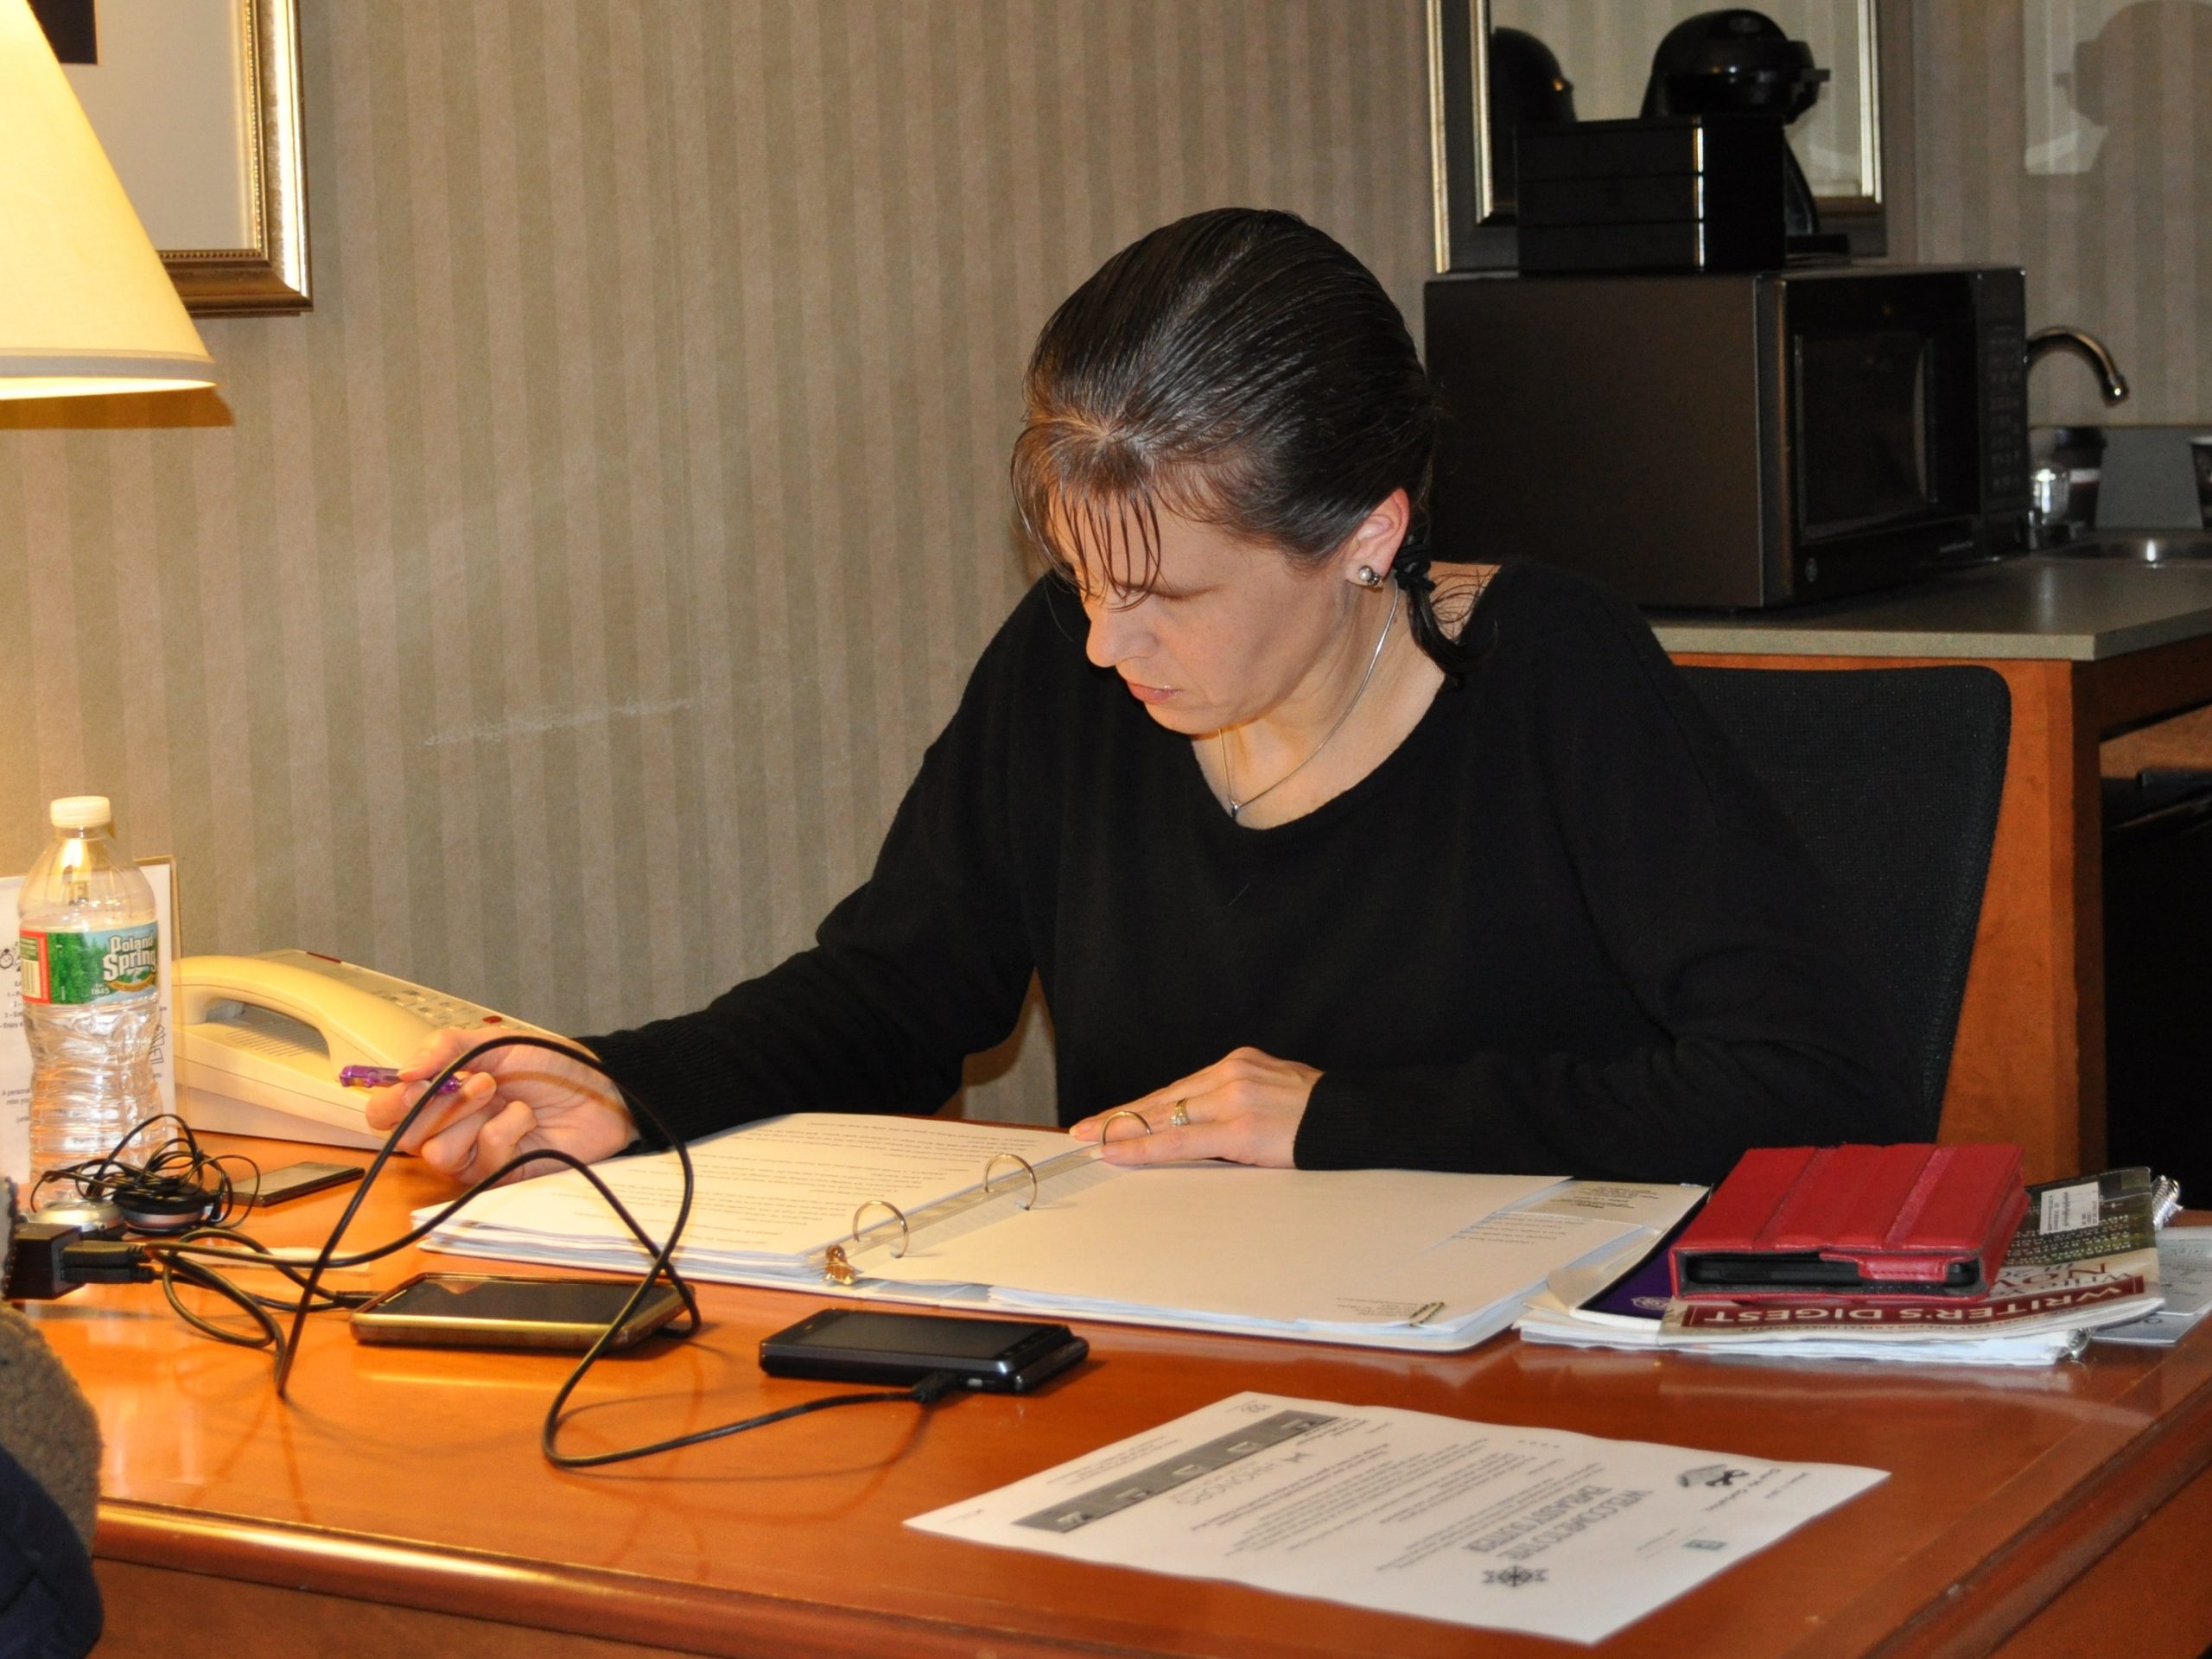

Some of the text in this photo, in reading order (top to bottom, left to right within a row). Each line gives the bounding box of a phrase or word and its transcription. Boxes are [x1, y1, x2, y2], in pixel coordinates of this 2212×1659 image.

[109, 931, 154, 955] Poland
[102, 949, 157, 982] Spring
[2039, 1274, 2132, 1290] Write
[1705, 1287, 2120, 1323] WRITER'S DIGEST
[1516, 1484, 1615, 1524] EMBASSY
[1548, 1488, 1656, 1533] WELCOME
[1527, 1529, 1575, 1543] TO
